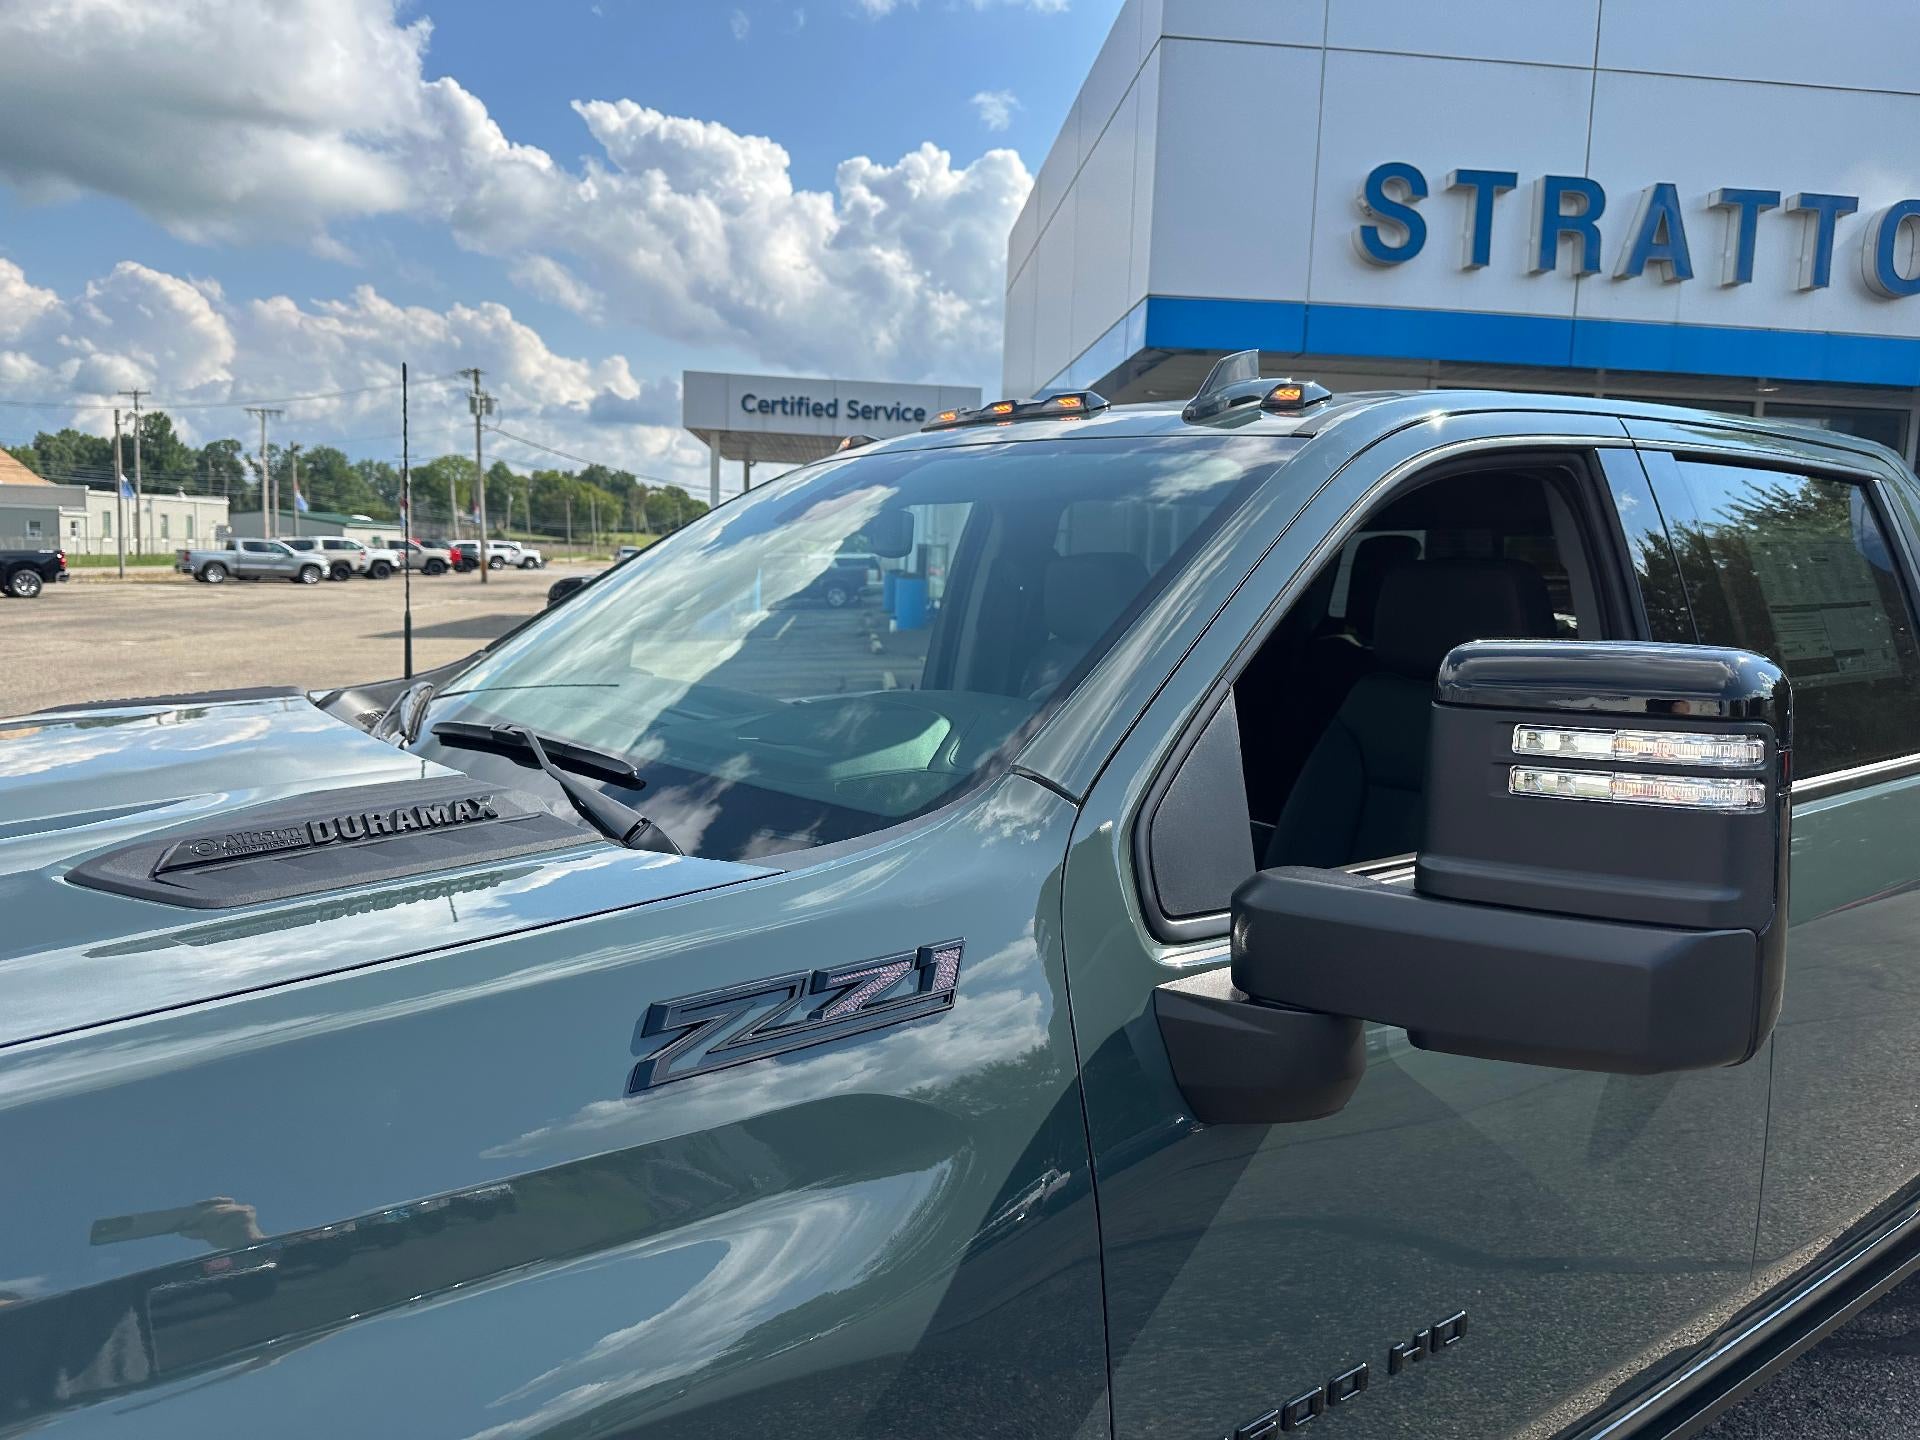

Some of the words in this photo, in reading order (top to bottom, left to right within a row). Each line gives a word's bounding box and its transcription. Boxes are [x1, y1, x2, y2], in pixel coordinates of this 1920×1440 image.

[1354, 161, 1920, 299] STRATTO
[741, 392, 838, 419] Certified
[847, 399, 926, 422] Service
[308, 795, 499, 845] DURAMAX
[629, 937, 966, 1096] Z71
[1223, 1362, 1369, 1440] 500
[1388, 1309, 1468, 1376] HD
